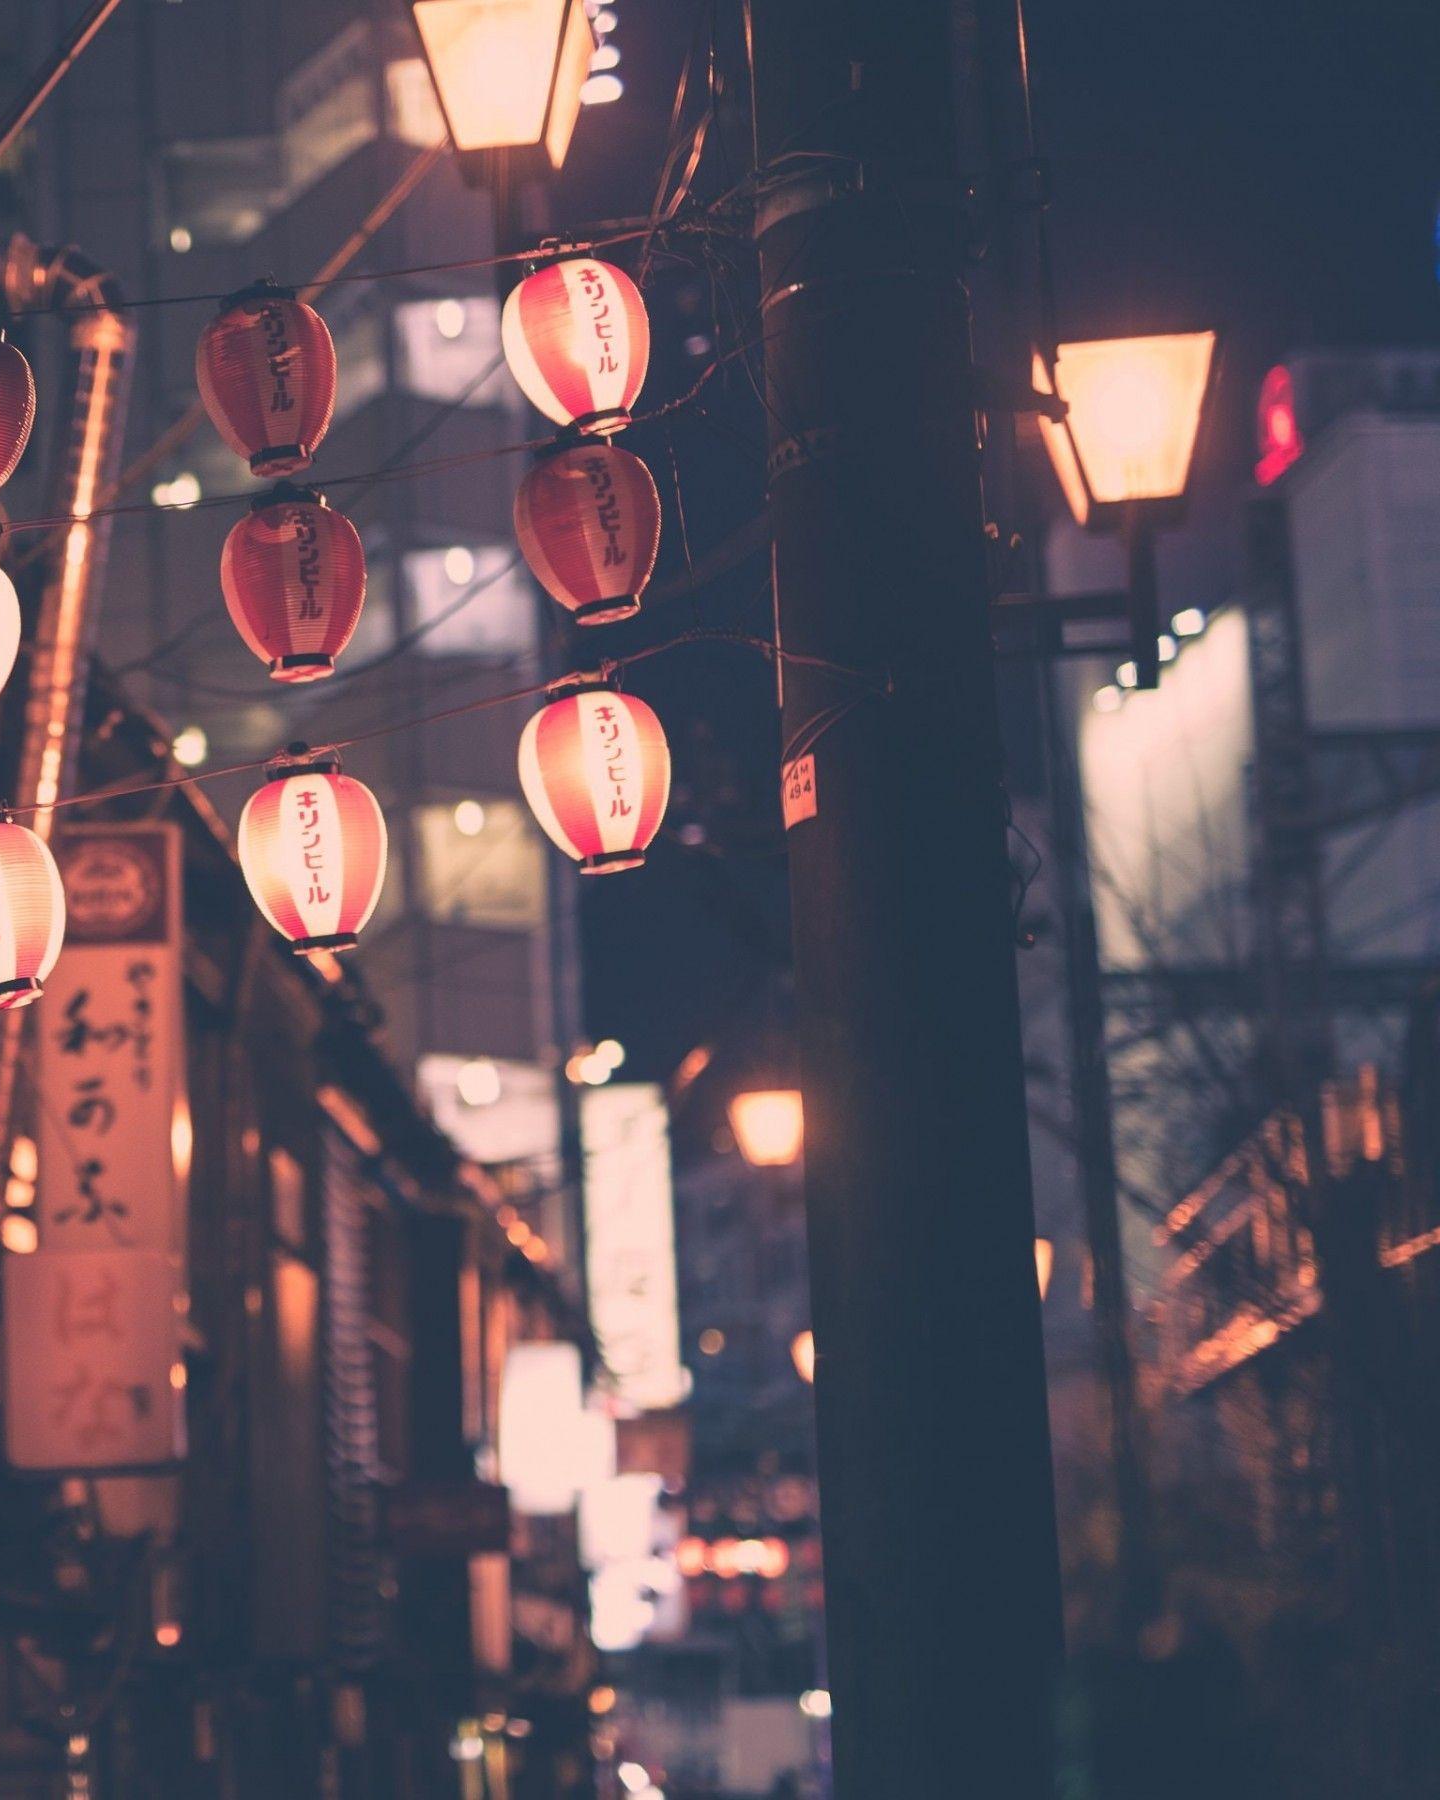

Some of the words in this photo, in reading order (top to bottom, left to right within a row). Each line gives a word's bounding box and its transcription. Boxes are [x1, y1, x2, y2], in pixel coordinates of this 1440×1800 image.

[288, 507, 324, 621] キリンビール
[583, 456, 627, 567] キリンビール
